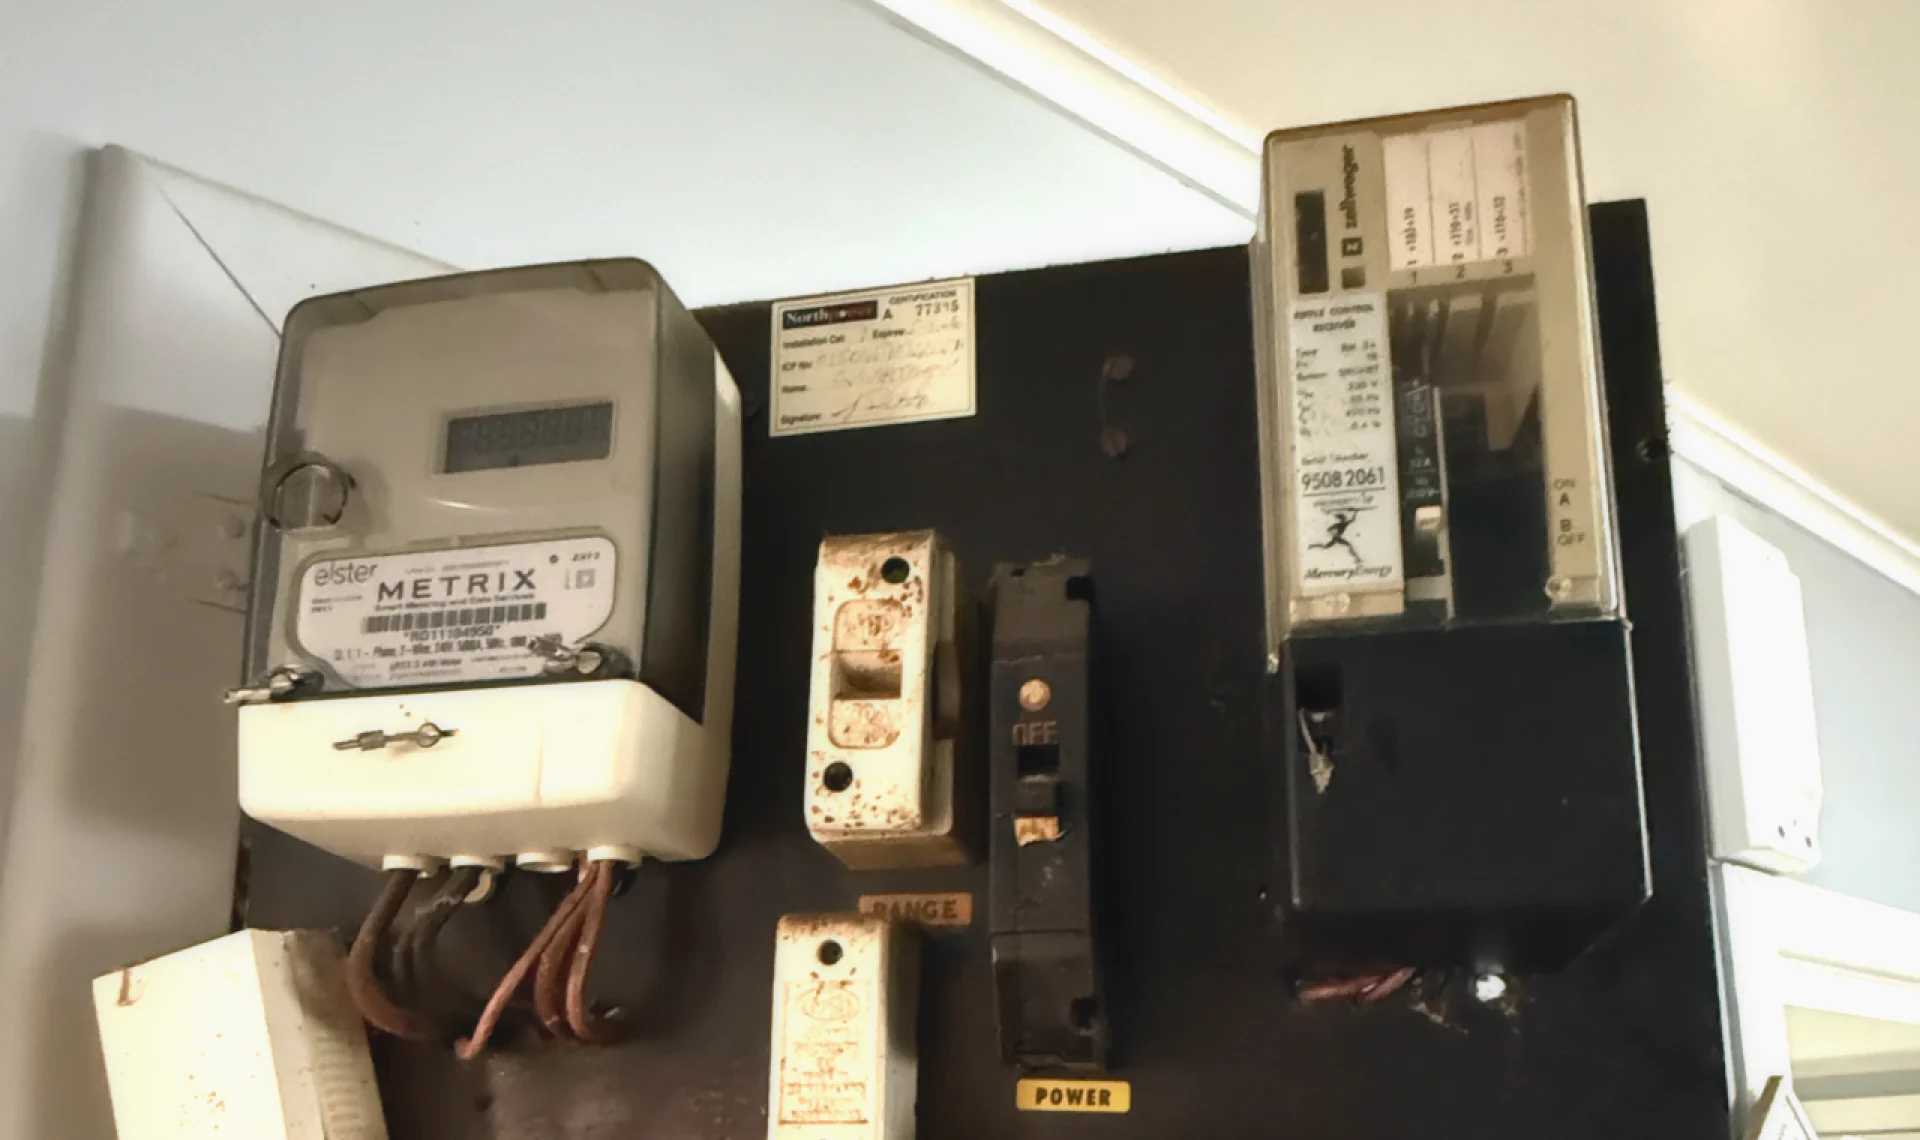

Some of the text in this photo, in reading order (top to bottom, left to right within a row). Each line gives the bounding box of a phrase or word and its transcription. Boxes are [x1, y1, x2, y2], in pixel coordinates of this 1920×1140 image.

[883, 308, 893, 320] A
[1560, 491, 1570, 506] A
[1560, 518, 1572, 532] B
[314, 562, 378, 588] elster
[376, 568, 538, 602] METRIX
[1012, 722, 1058, 745] OFF
[872, 899, 958, 921] RANGE
[1035, 1086, 1112, 1106] POWER
